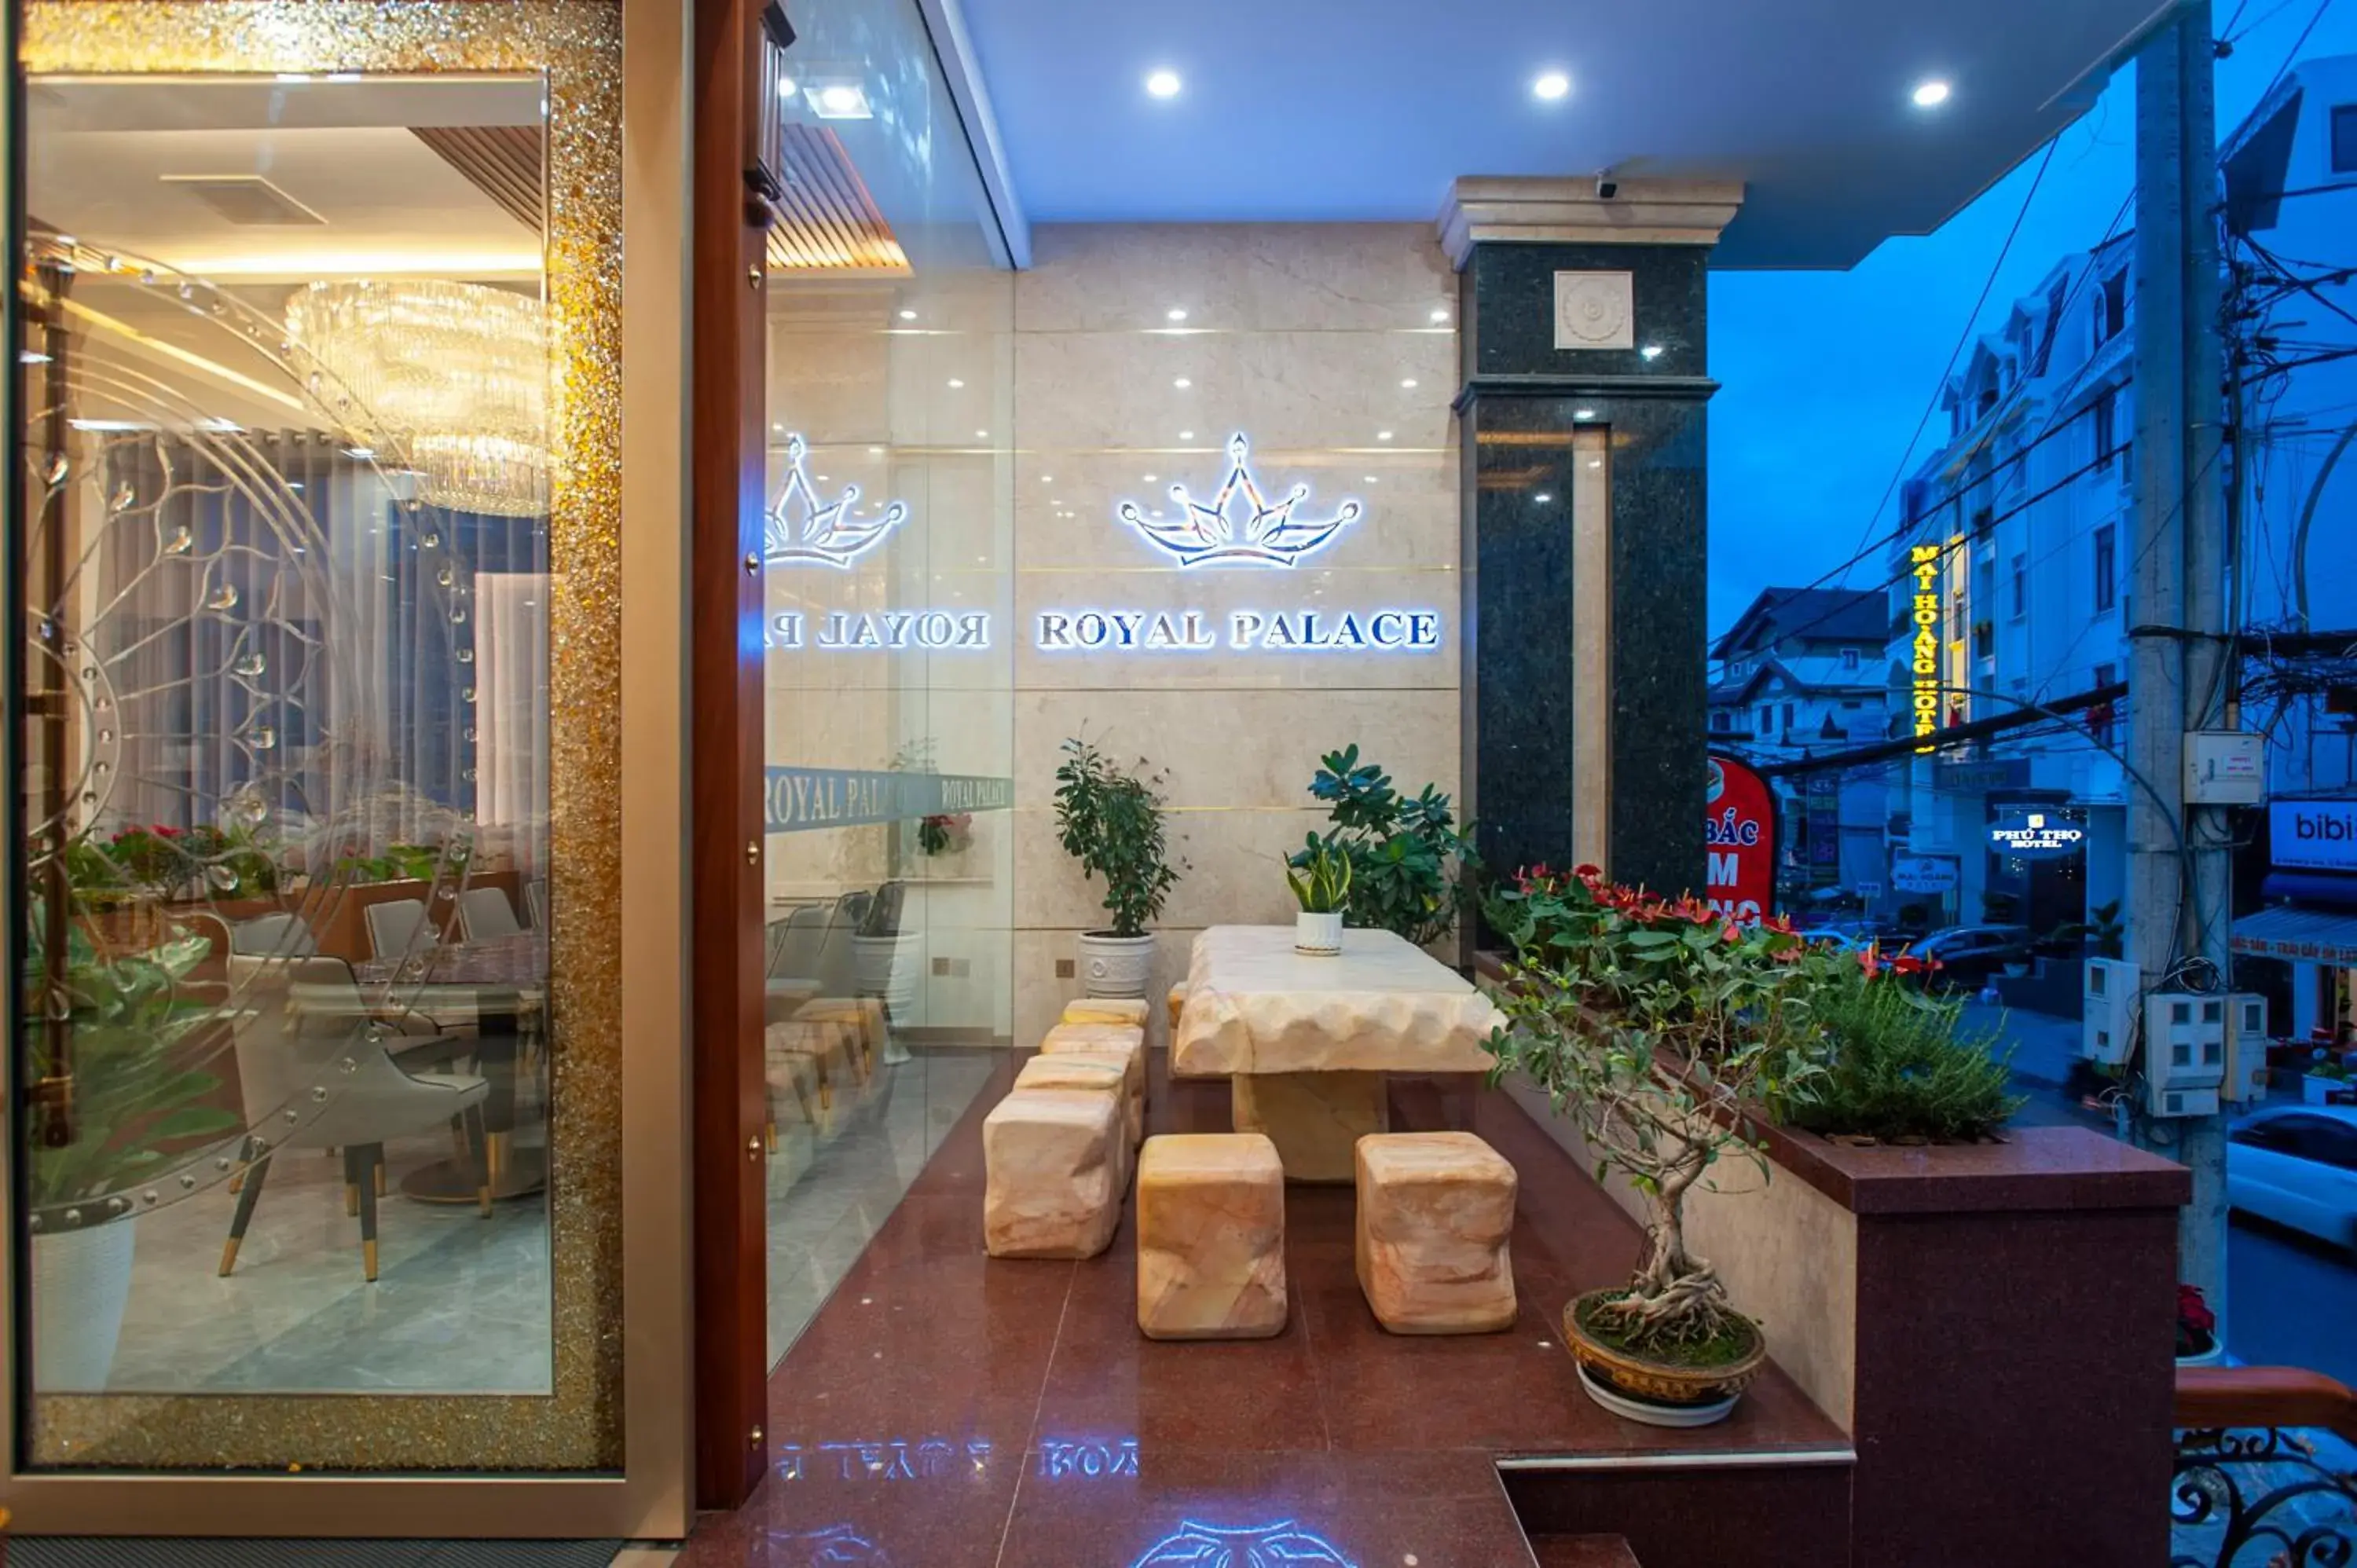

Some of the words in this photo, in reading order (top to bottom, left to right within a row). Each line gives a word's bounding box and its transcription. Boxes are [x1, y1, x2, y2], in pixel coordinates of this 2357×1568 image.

[1037, 612, 1213, 647] ROYAL
[1232, 612, 1439, 647] PALACE
[1913, 680, 1938, 753] HOTE
[1992, 828, 2035, 841] PHÚ
[2297, 813, 2357, 841] bibi
